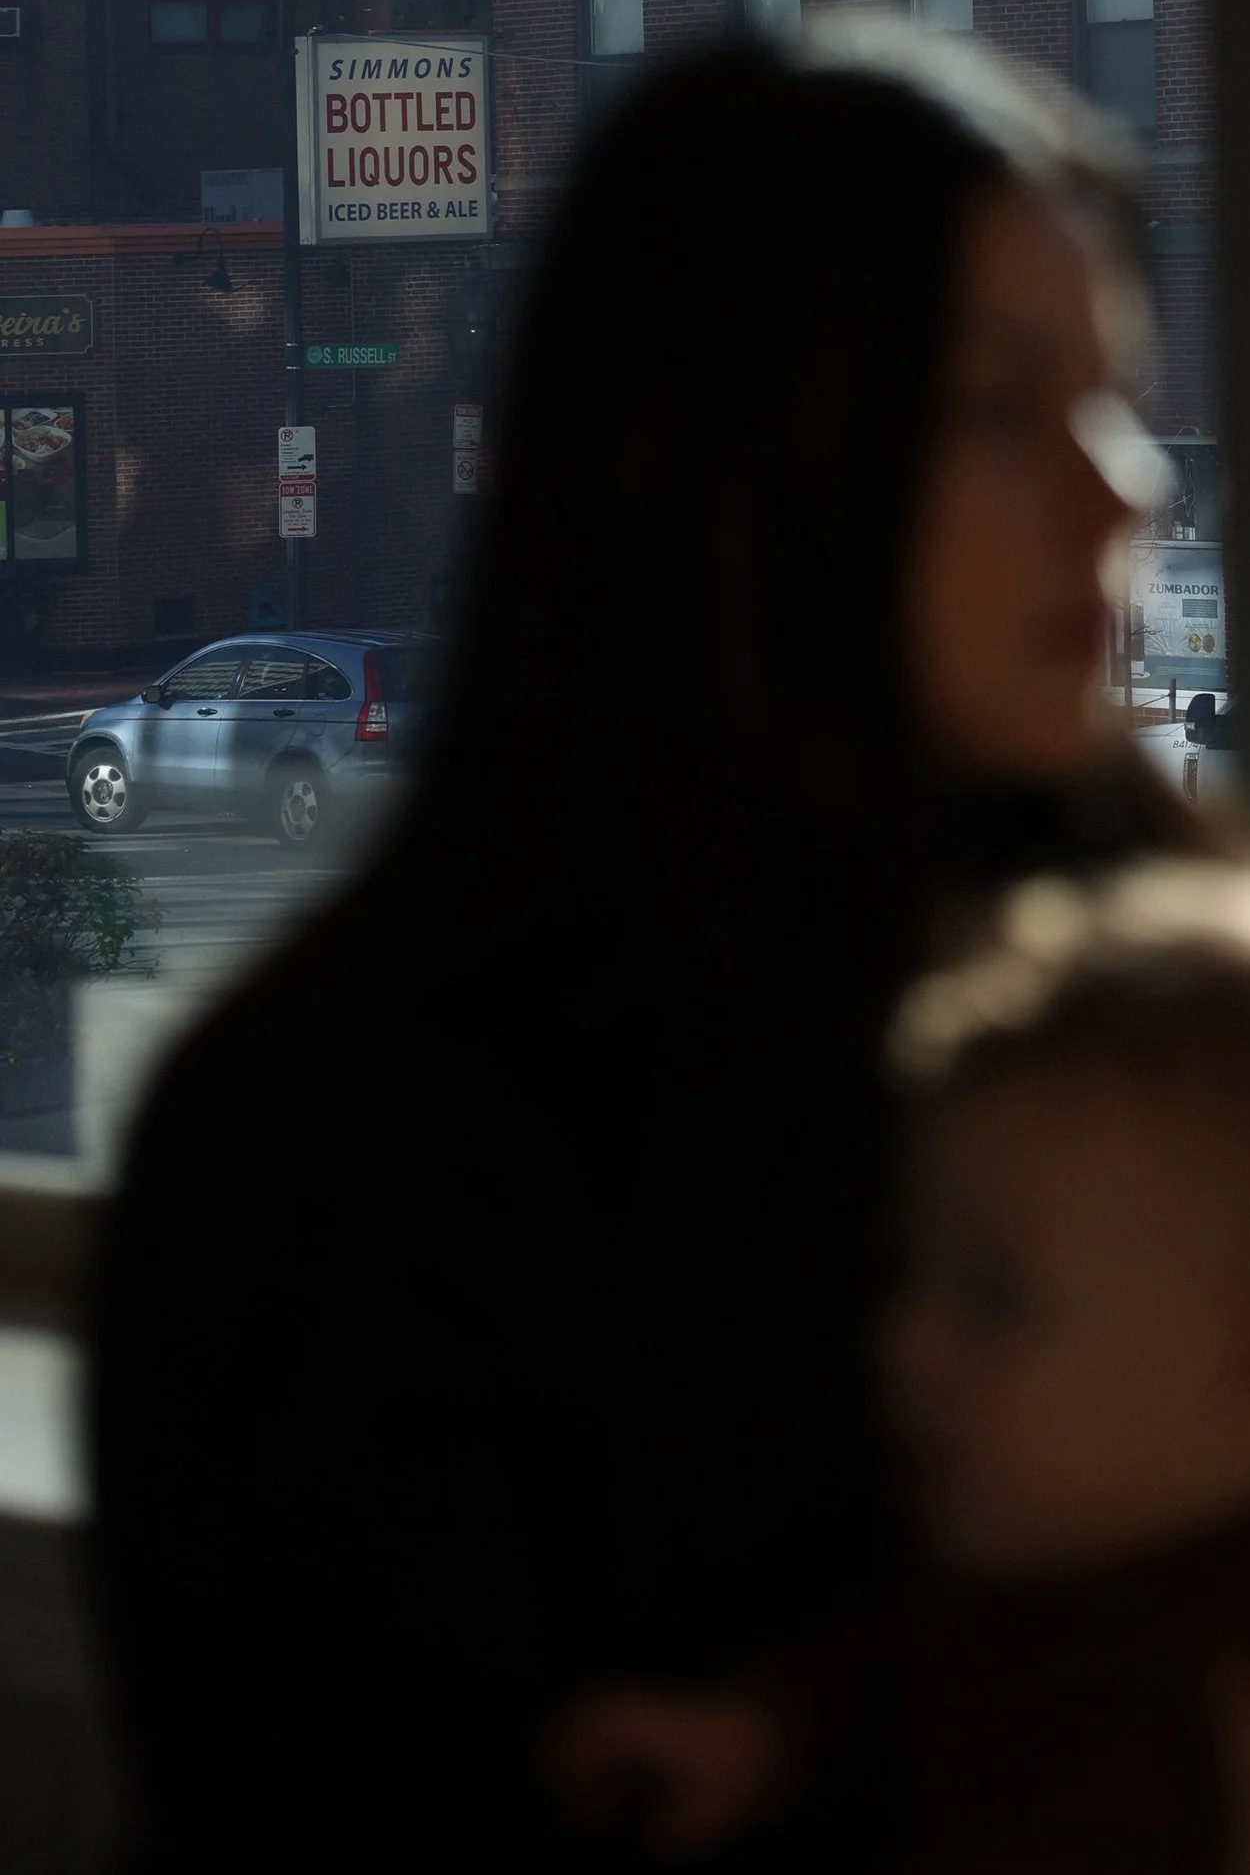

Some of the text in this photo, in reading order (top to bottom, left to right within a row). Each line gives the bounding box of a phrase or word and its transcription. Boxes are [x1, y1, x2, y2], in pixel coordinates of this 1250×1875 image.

[329, 57, 472, 80] SIMMONS
[326, 91, 476, 133] BOTTLED
[327, 144, 477, 187] LIQUORS
[329, 200, 478, 221] ICED BEER & ALE
[0, 307, 87, 336] eira's
[323, 347, 397, 364] S. RUSSELL ST
[281, 485, 314, 495] TOW ZONE
[1148, 583, 1219, 596] ZUMBADOR
